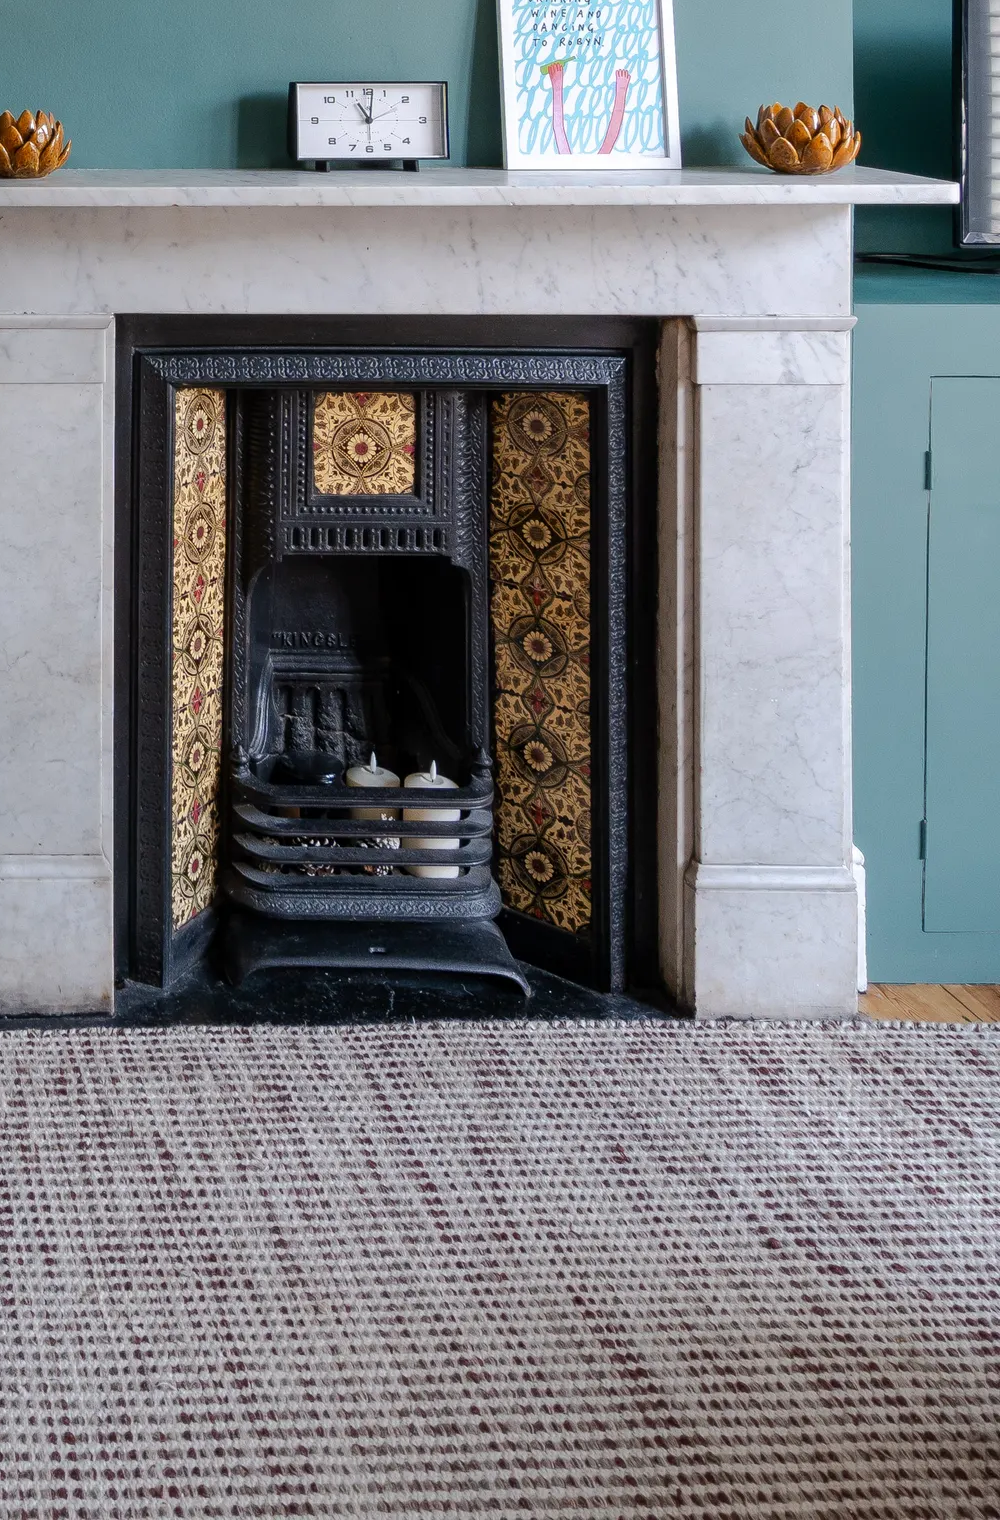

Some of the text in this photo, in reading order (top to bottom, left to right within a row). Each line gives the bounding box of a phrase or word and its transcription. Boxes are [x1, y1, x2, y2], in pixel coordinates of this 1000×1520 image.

[577, 9, 602, 18] AND
[533, 36, 604, 47] TO ROBYN.
